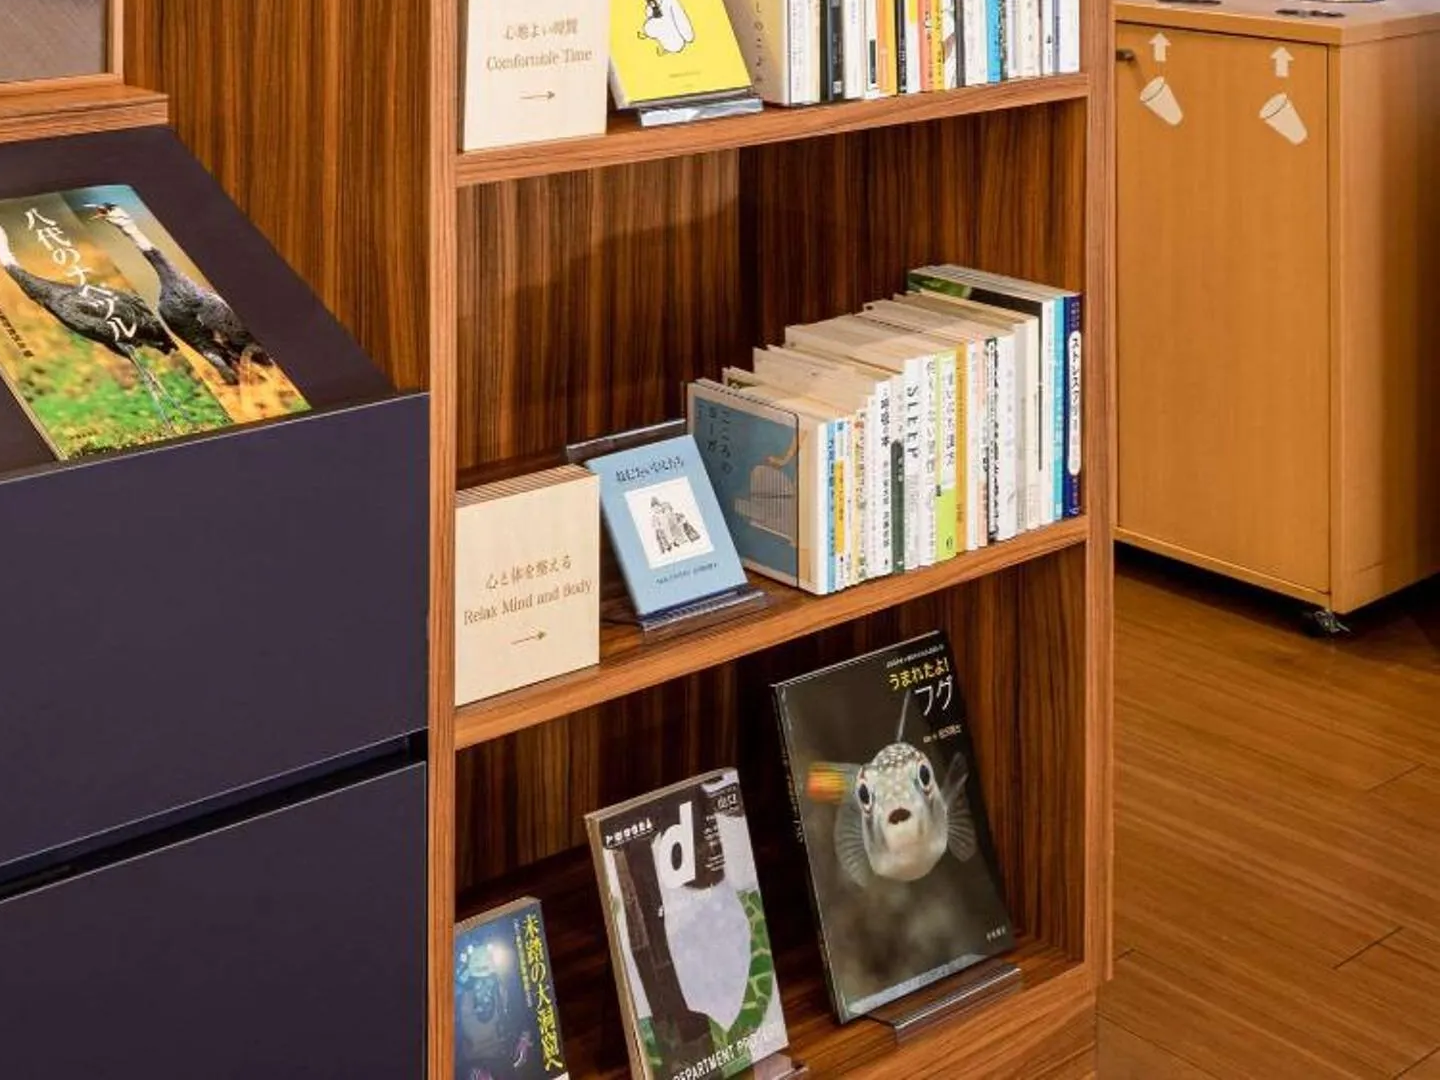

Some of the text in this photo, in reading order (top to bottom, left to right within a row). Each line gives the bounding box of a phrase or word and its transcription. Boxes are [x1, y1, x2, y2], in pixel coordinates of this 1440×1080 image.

[504, 17, 578, 41] 心地よい時間
[486, 47, 593, 72] Comfortable Time
[906, 384, 920, 459] SLEEP
[485, 554, 573, 589] 心と体を整える
[463, 578, 593, 626] Relax Mind and Body
[913, 673, 953, 716] フグ
